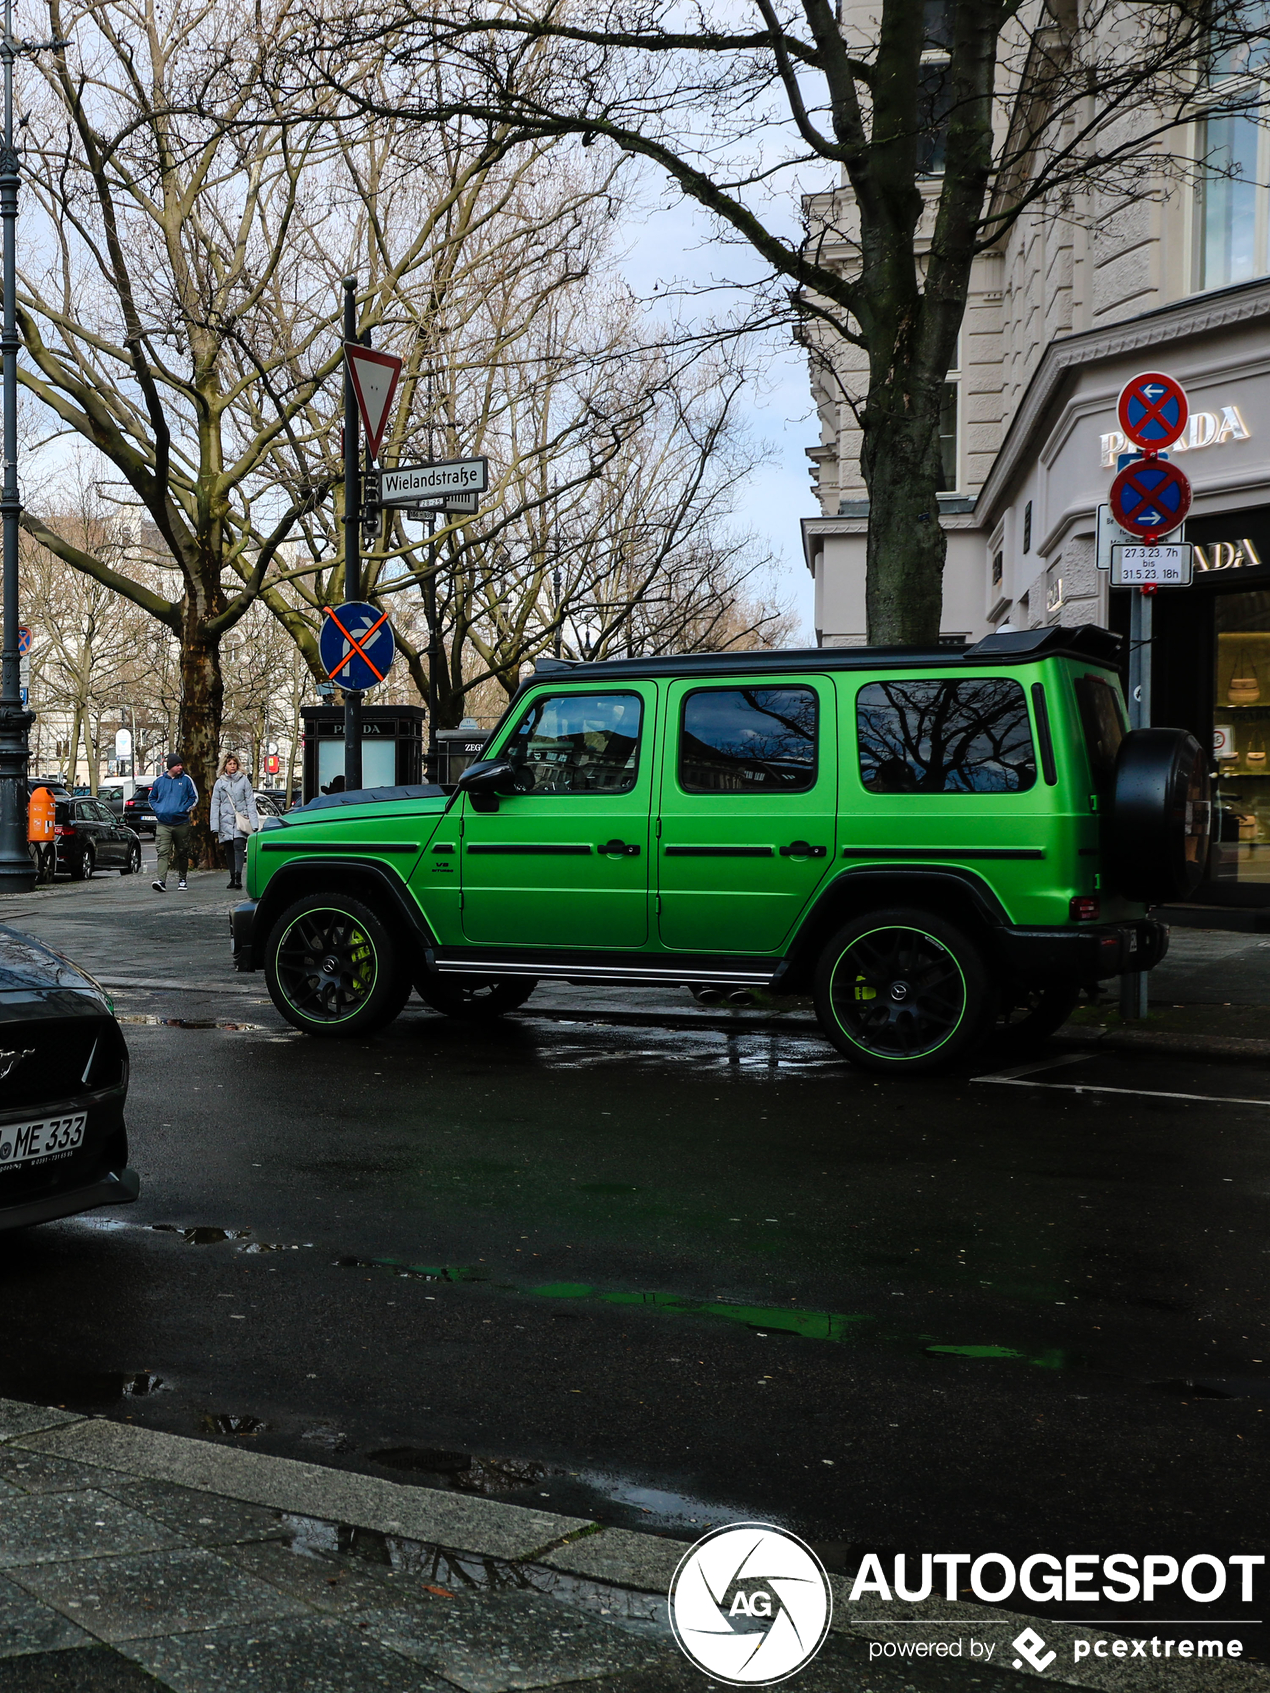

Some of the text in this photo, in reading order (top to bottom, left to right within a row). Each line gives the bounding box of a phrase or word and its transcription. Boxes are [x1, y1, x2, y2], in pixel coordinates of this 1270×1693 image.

[1099, 405, 1251, 467] PDA
[386, 467, 477, 491] Wielandstraße
[1166, 548, 1178, 557] 7h
[1163, 569, 1179, 578] 18h
[334, 724, 381, 734] PDA
[465, 744, 484, 752] ZEG
[13, 1124, 44, 1158] ME
[45, 1116, 85, 1151] 333
